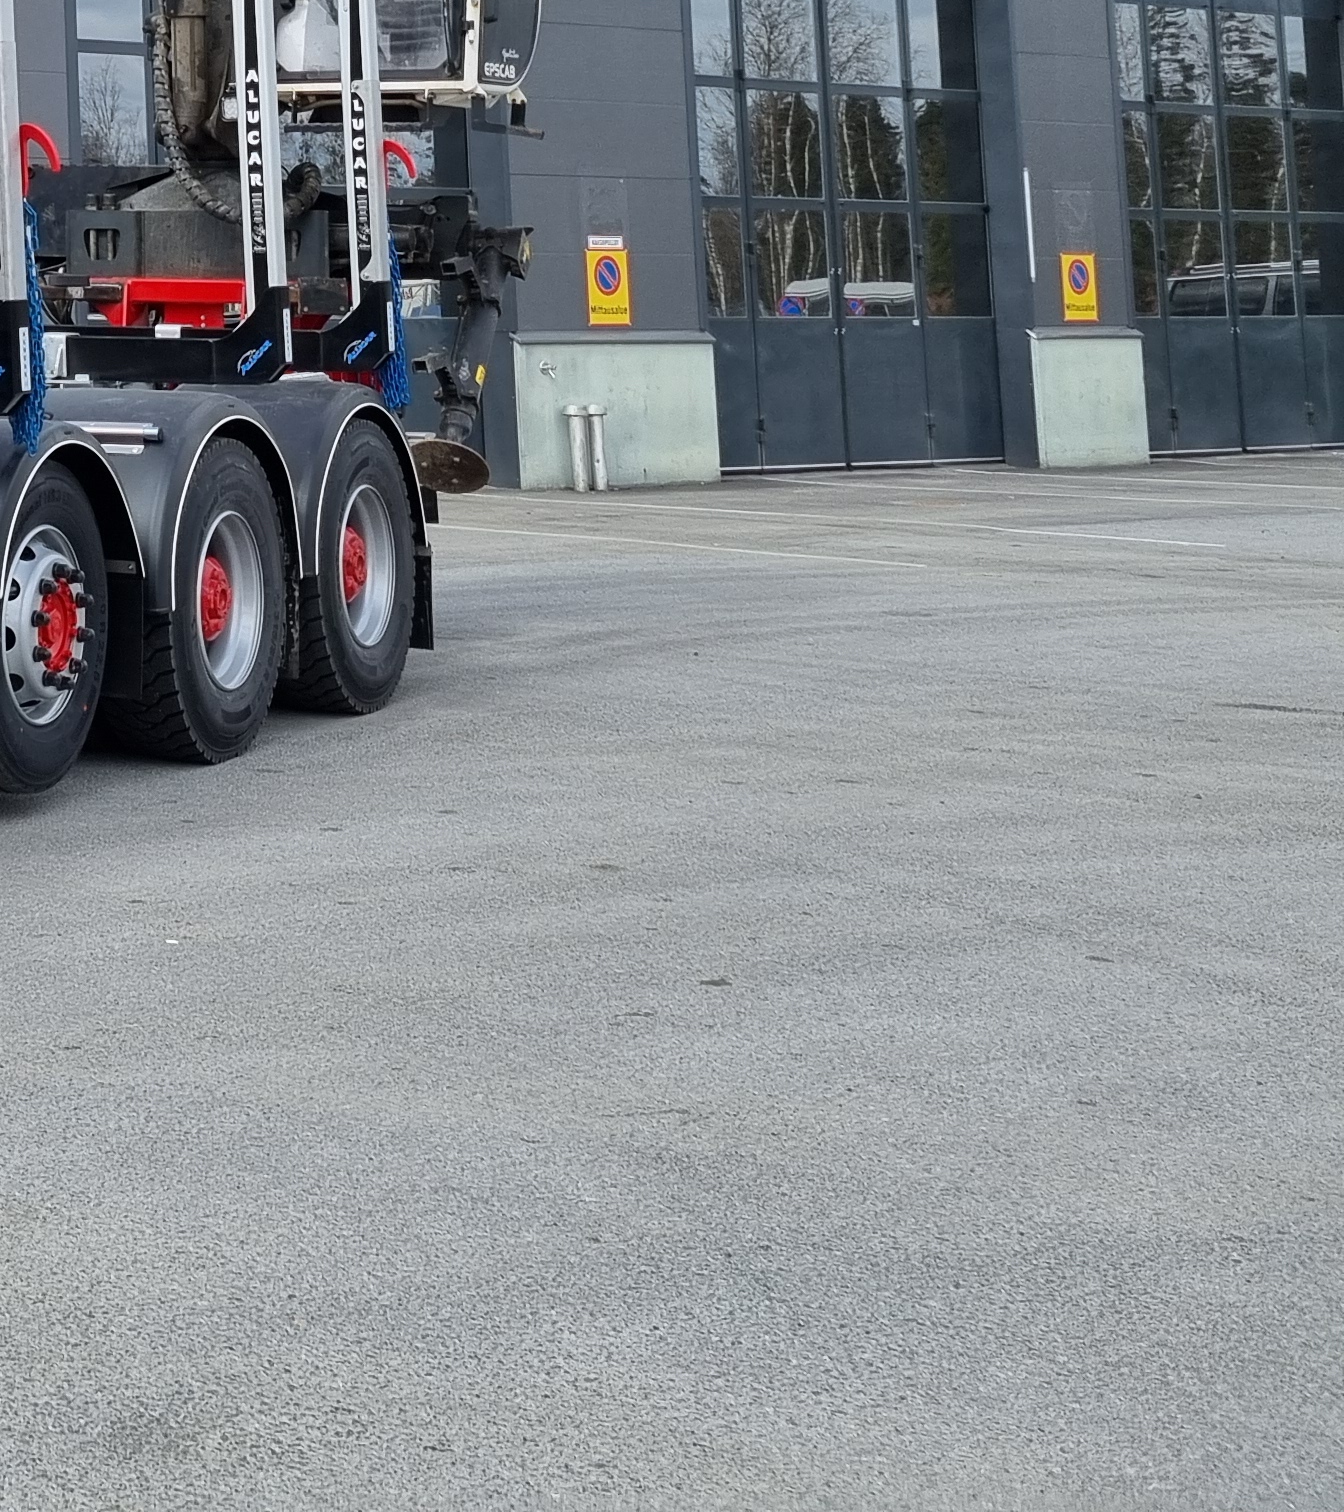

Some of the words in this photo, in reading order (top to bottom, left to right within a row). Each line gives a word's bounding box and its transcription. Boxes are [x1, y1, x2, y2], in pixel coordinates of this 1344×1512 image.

[484, 62, 516, 79] EPSCAB
[246, 69, 263, 187] ALUCAR
[351, 98, 368, 189] LUCAR
